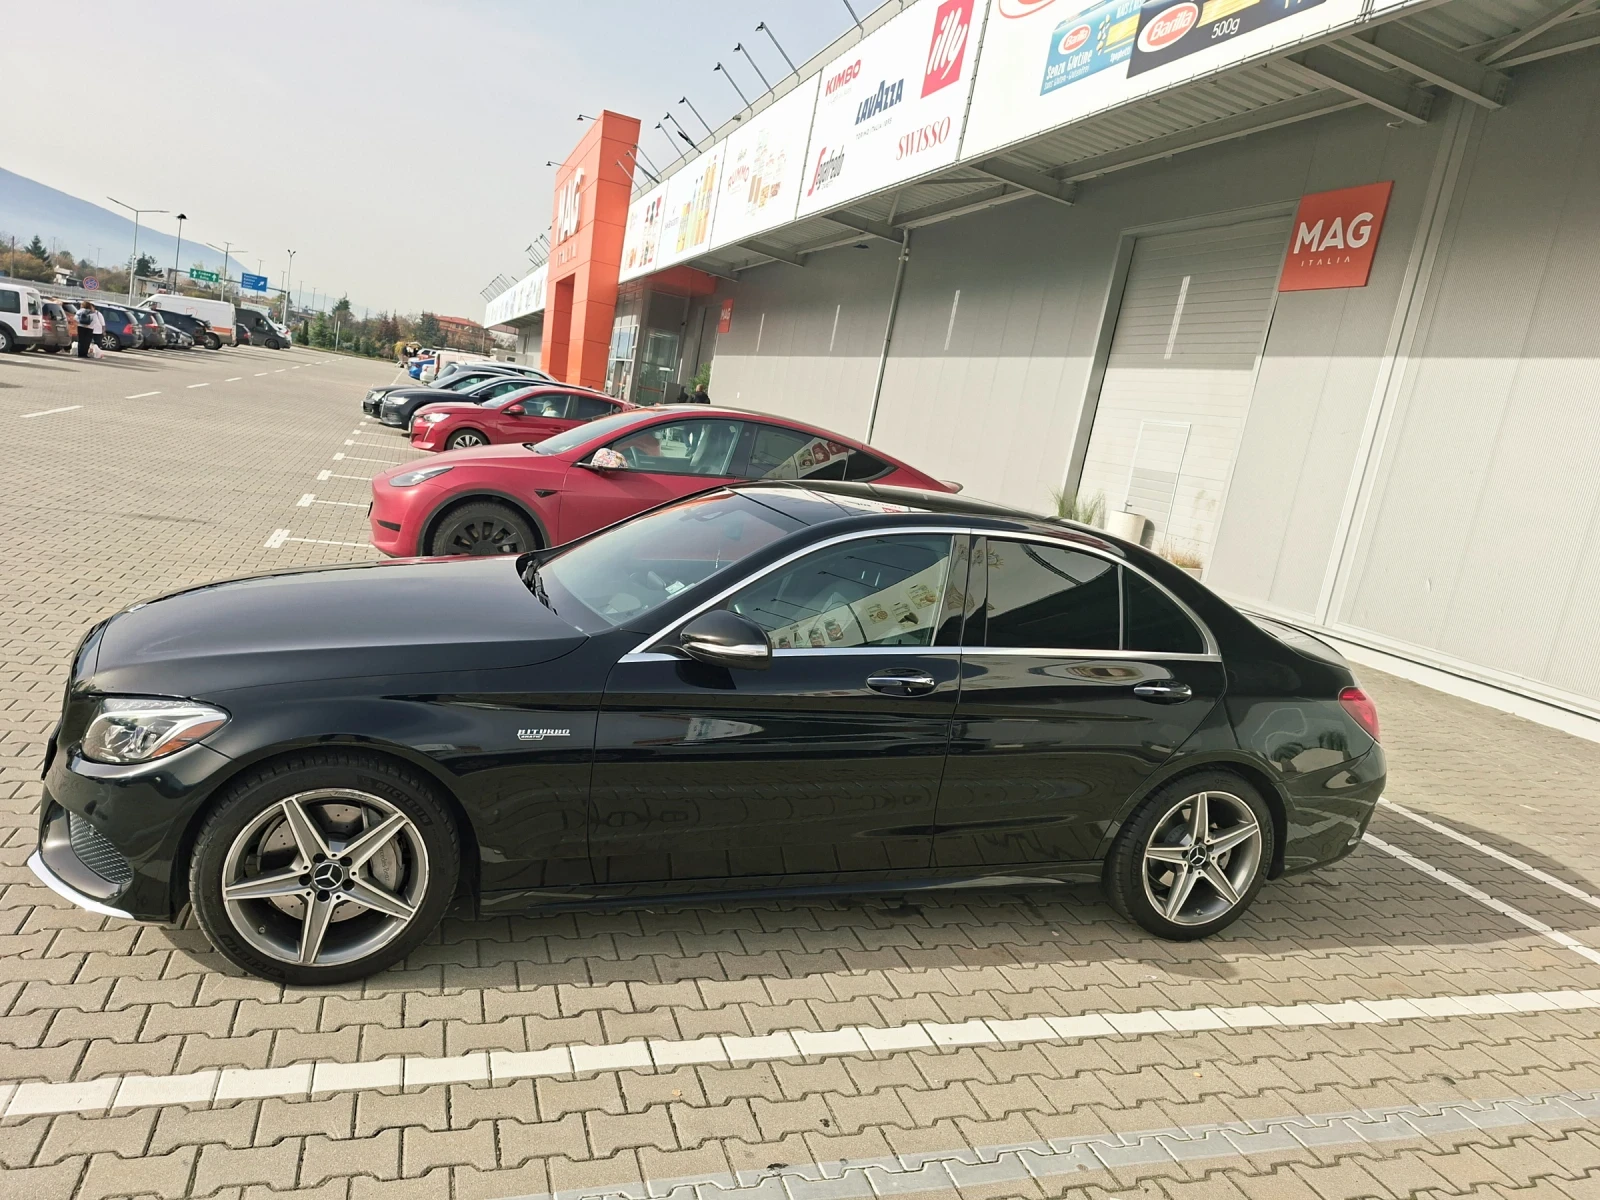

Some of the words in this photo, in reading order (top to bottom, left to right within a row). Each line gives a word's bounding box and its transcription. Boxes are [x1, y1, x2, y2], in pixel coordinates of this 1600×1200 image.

[1064, 27, 1089, 49] Barilla
[1149, 9, 1194, 42] Barilla
[1211, 17, 1241, 39] 500g
[927, 7, 969, 81] illy
[825, 59, 862, 97] KIMBO
[854, 78, 905, 126] LAVAZZA
[896, 116, 951, 161] SWISSO
[556, 167, 585, 246] MAG
[1293, 211, 1374, 255] MAG
[1300, 255, 1351, 267] ITALIA
[720, 307, 731, 320] MAG
[518, 728, 570, 736] BITURBO
